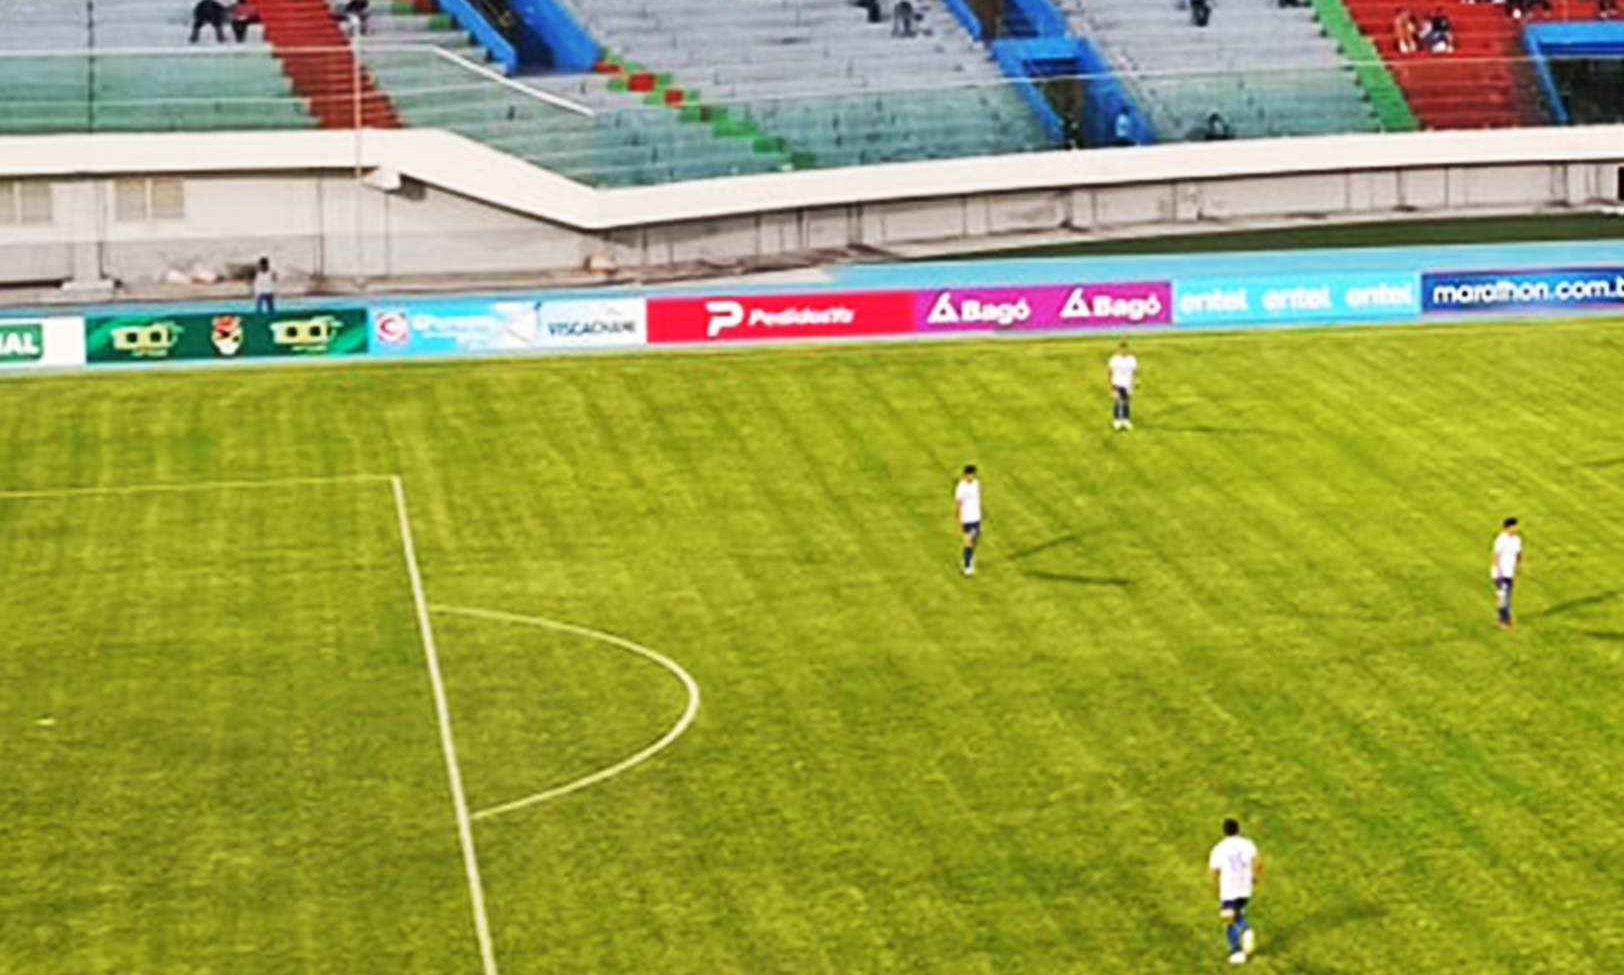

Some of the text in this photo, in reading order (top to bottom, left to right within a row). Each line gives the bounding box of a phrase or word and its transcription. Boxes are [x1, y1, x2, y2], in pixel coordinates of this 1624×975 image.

[1093, 293, 1162, 322] Bagó
[1180, 286, 1248, 313] entel
[1262, 283, 1331, 311] entel
[1345, 281, 1413, 307] entel
[748, 307, 854, 328] PedidosYa
[961, 298, 1031, 326] Bagó
